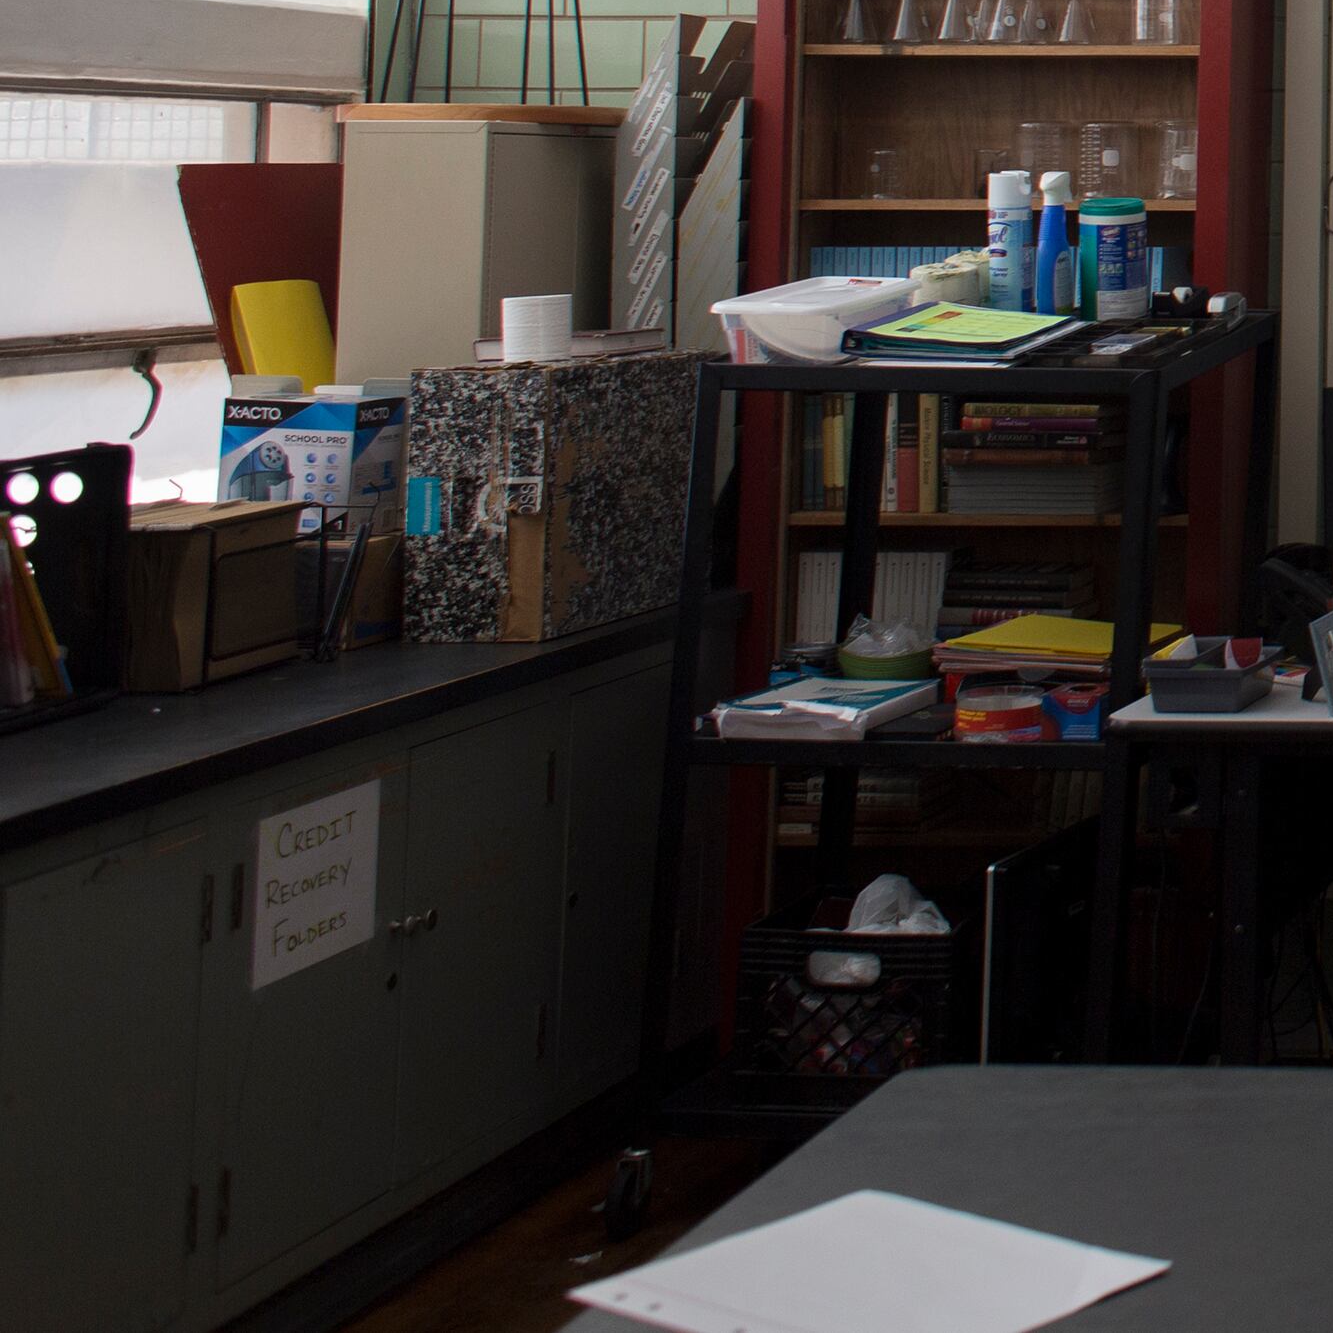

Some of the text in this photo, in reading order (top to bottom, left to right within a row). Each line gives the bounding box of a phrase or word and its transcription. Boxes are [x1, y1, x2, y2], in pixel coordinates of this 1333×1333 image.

[226, 405, 282, 421] X-ACTO
[285, 434, 348, 444] SCHOOL PRO
[277, 810, 357, 858] CREDIT
[265, 857, 353, 909] RECOVERY
[272, 910, 348, 957] FOLDERS
